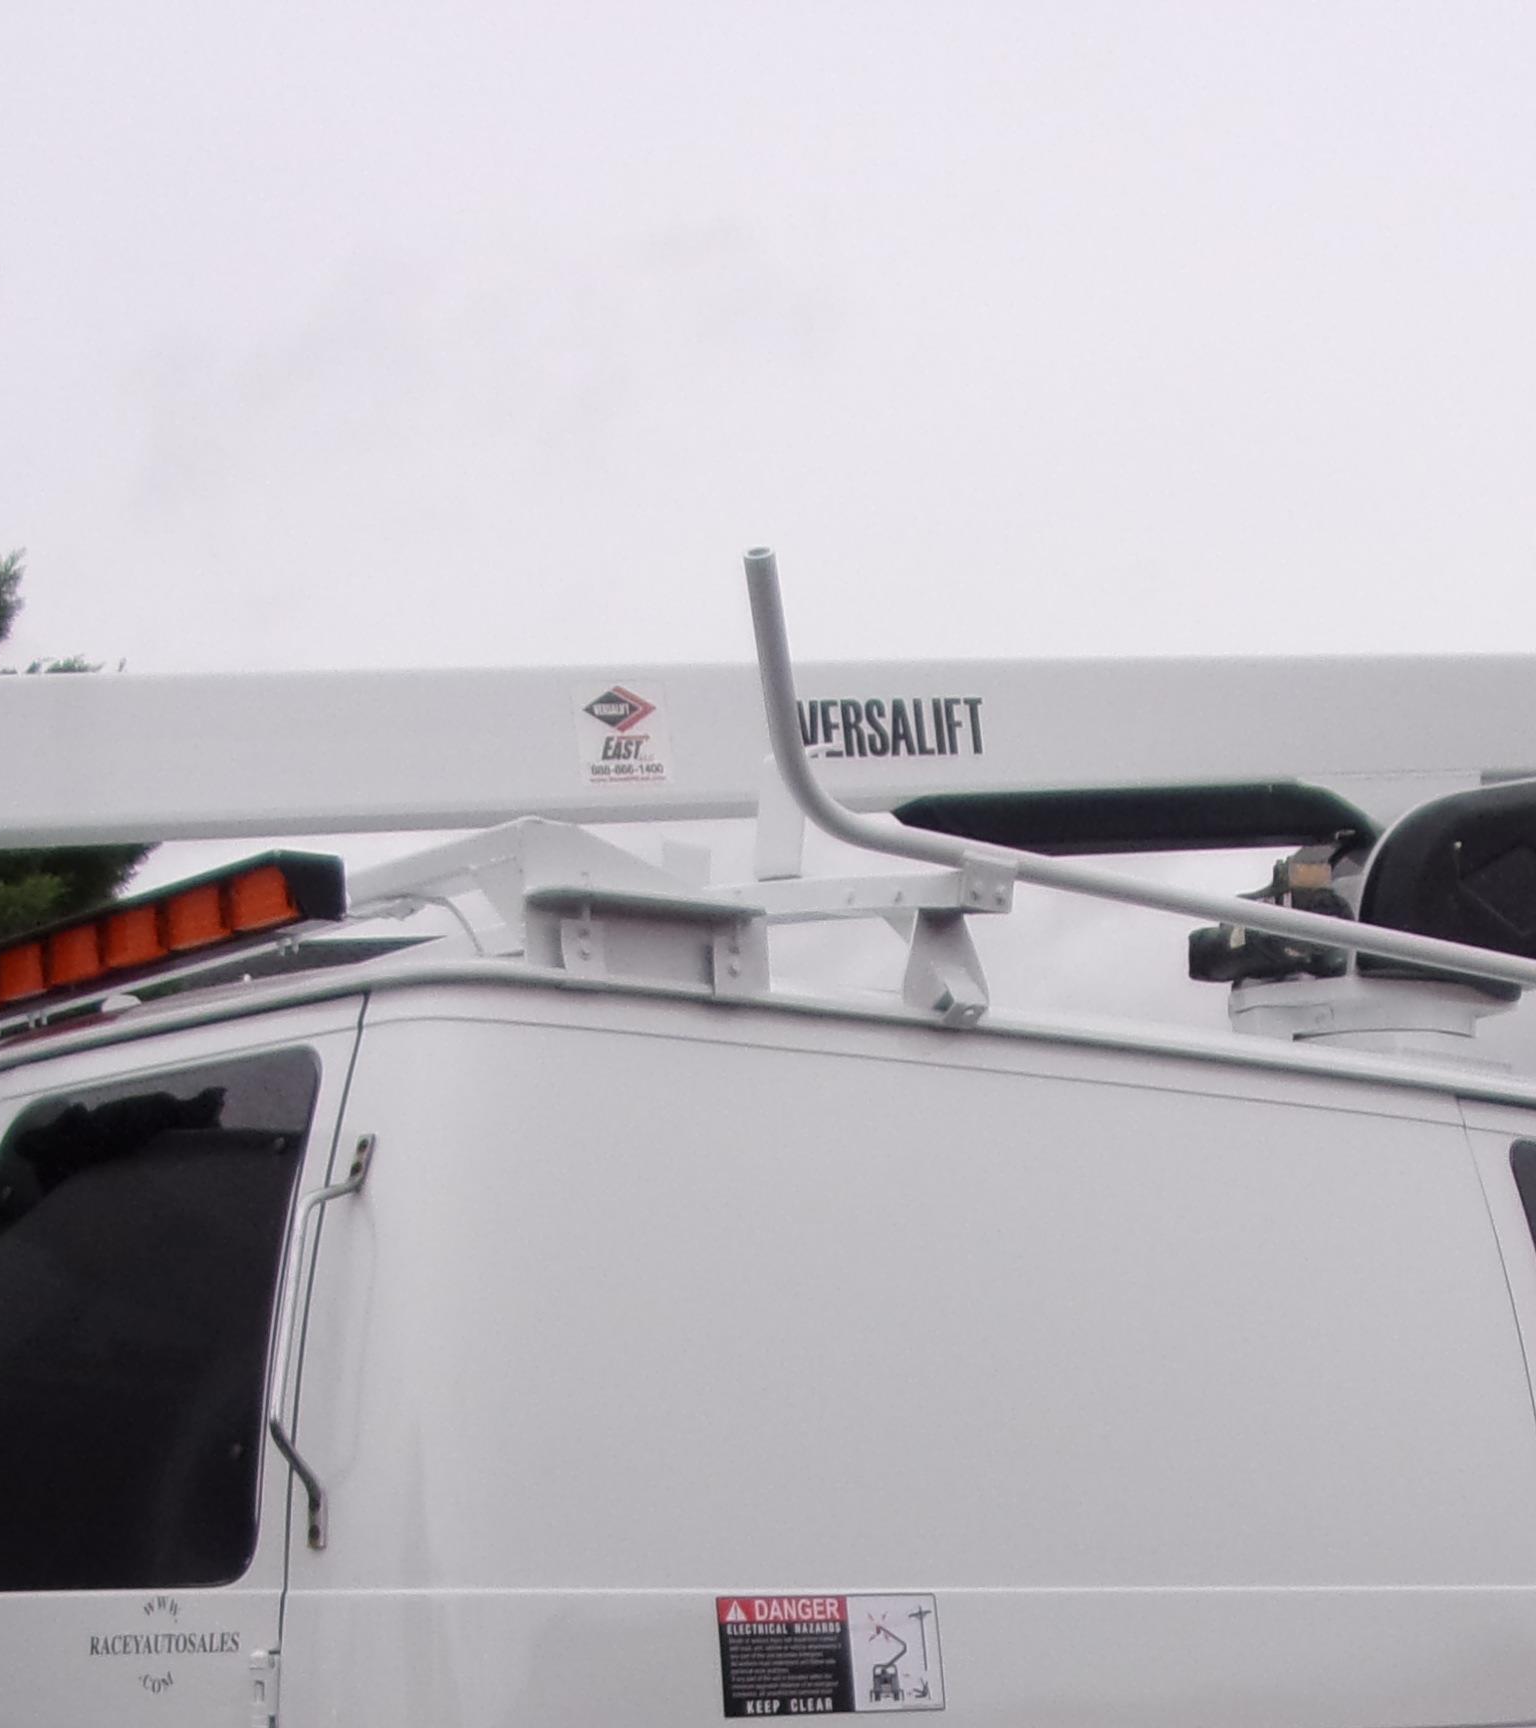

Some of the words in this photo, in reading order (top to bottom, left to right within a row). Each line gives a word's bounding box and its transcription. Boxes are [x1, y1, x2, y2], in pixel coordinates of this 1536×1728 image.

[797, 697, 983, 758] VERSALIFT
[602, 736, 644, 761] EAST
[754, 1599, 841, 1621] DANGER
[727, 1623, 788, 1636] ELECTRICAL
[794, 1622, 842, 1635] HAZARDS
[89, 1631, 241, 1656] RACEYAUTOSALES
[746, 1700, 780, 1715] KEEP
[791, 1698, 834, 1712] CLEAR
